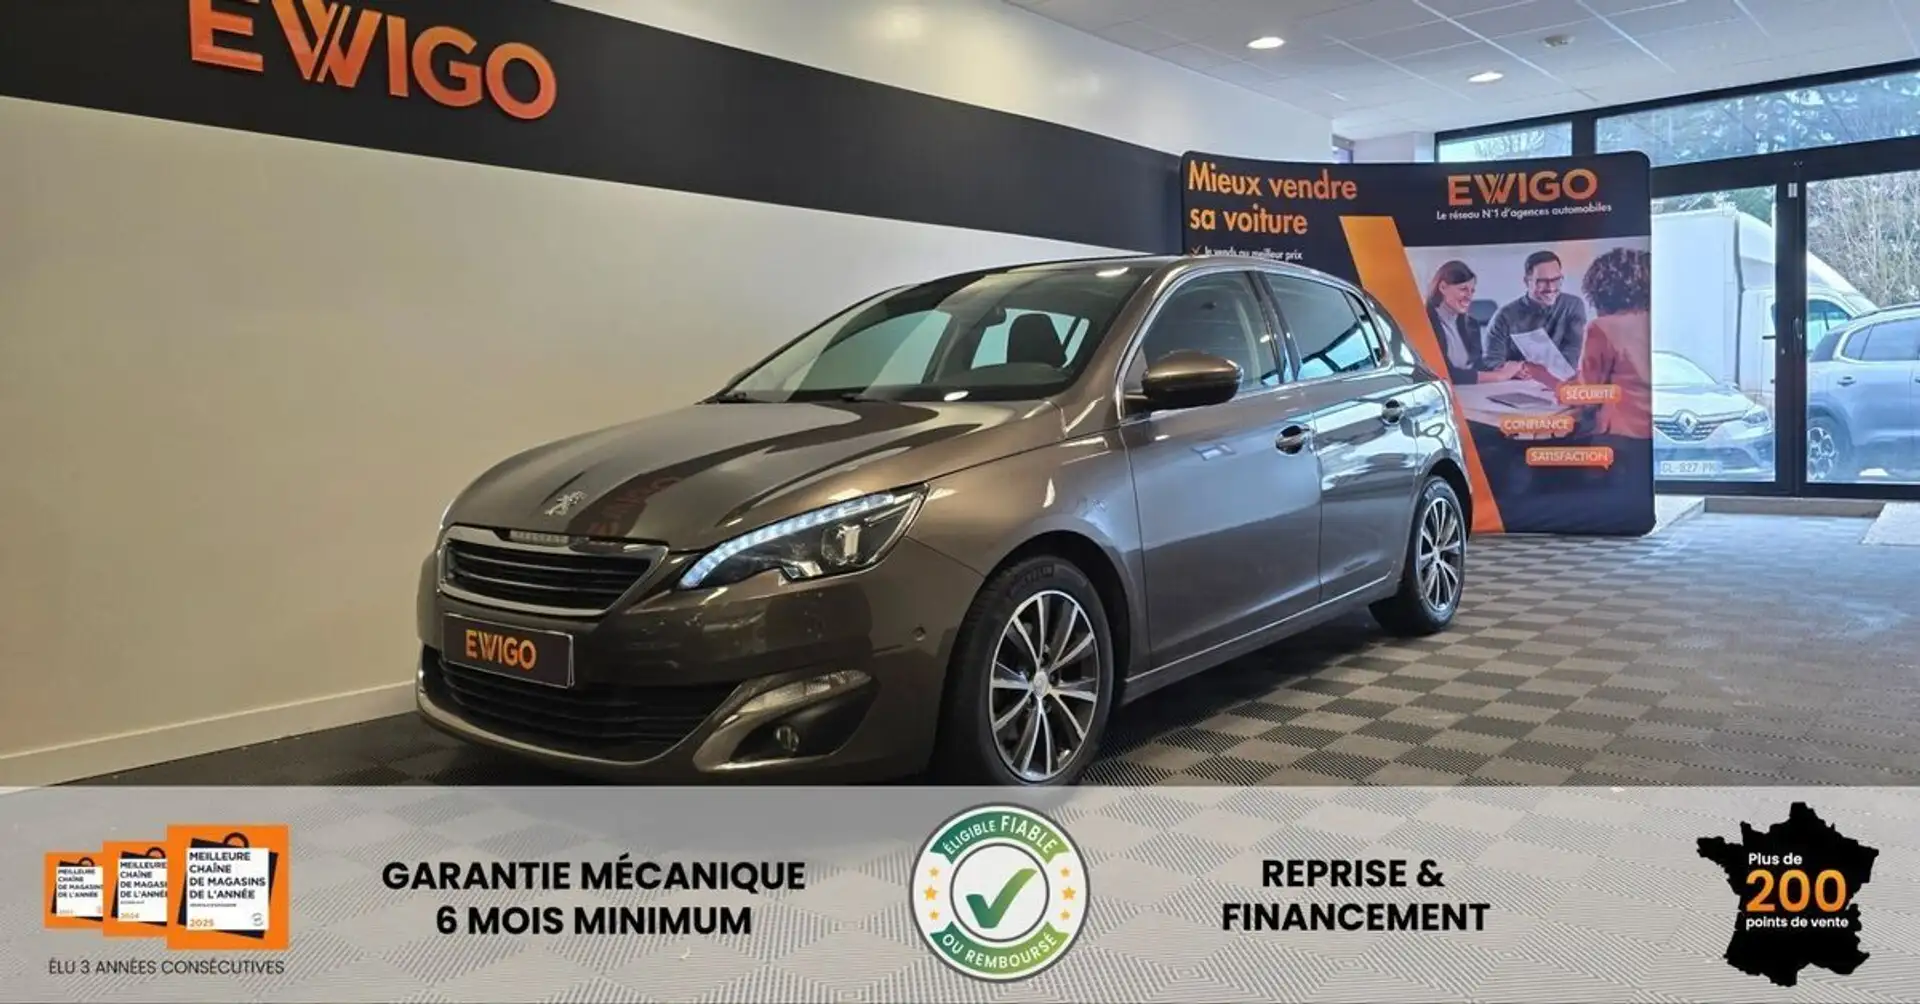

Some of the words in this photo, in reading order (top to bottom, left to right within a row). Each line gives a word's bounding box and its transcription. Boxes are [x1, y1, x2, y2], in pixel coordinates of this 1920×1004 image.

[189, 0, 557, 119] EWIGO
[1188, 160, 1262, 196] Mieux
[1268, 168, 1357, 200] vendre
[1447, 168, 1598, 205] EWIGO
[1190, 207, 1215, 230] sa
[1223, 203, 1308, 234] voiture
[1436, 209, 1447, 220] Le
[1449, 210, 1480, 220] réseau
[1501, 207, 1549, 219] d'agences
[1552, 203, 1612, 215] automobiles
[1285, 249, 1303, 261] prix
[1503, 418, 1569, 430] CONFIANCE
[1530, 450, 1609, 462] SATISFACTION
[465, 628, 537, 670] EWIGO
